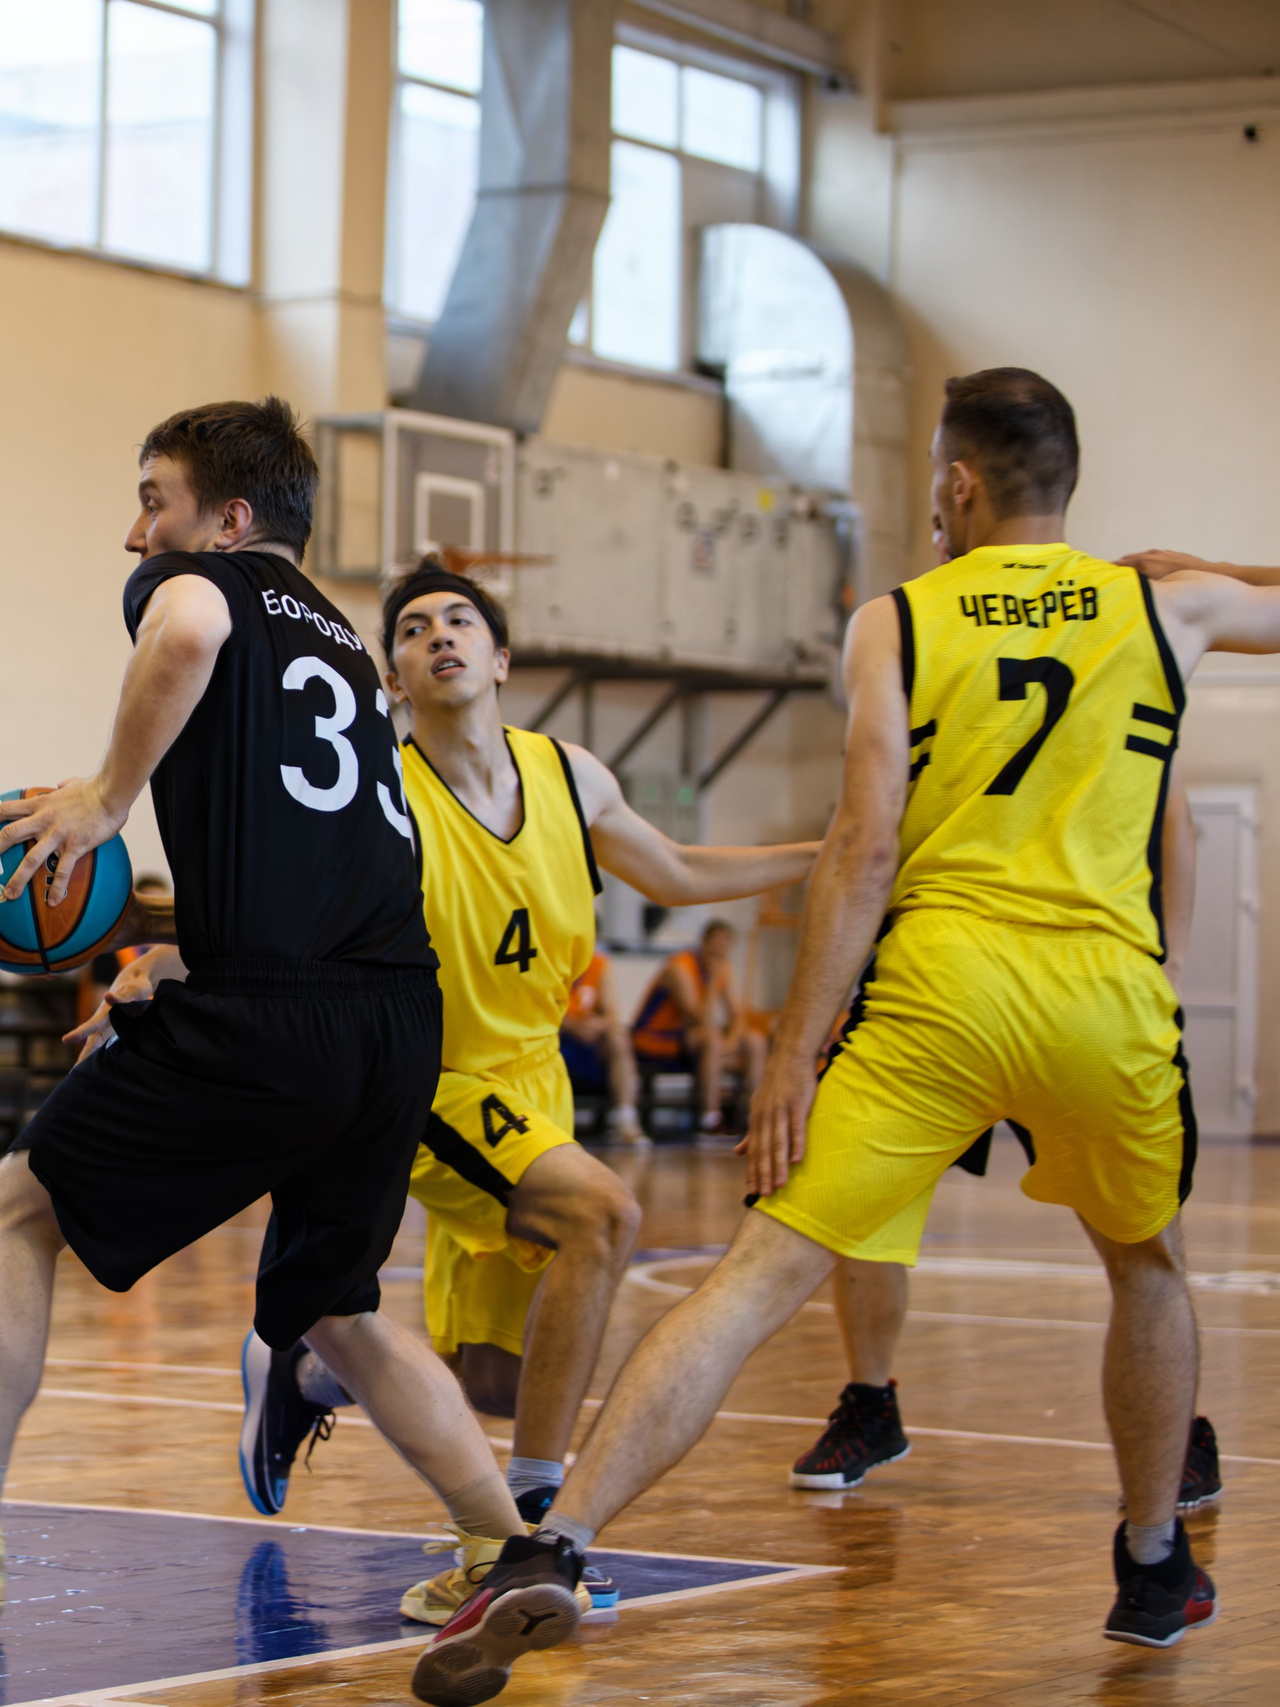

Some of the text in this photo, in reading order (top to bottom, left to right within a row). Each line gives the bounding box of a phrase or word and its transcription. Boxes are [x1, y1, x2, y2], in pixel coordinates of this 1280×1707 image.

[261, 588, 371, 655] БОРОДУ
[959, 580, 1098, 628] ЧЕВЕРЁВ
[983, 656, 1075, 796] 7
[494, 907, 537, 973] 4
[481, 1093, 531, 1148] 4
